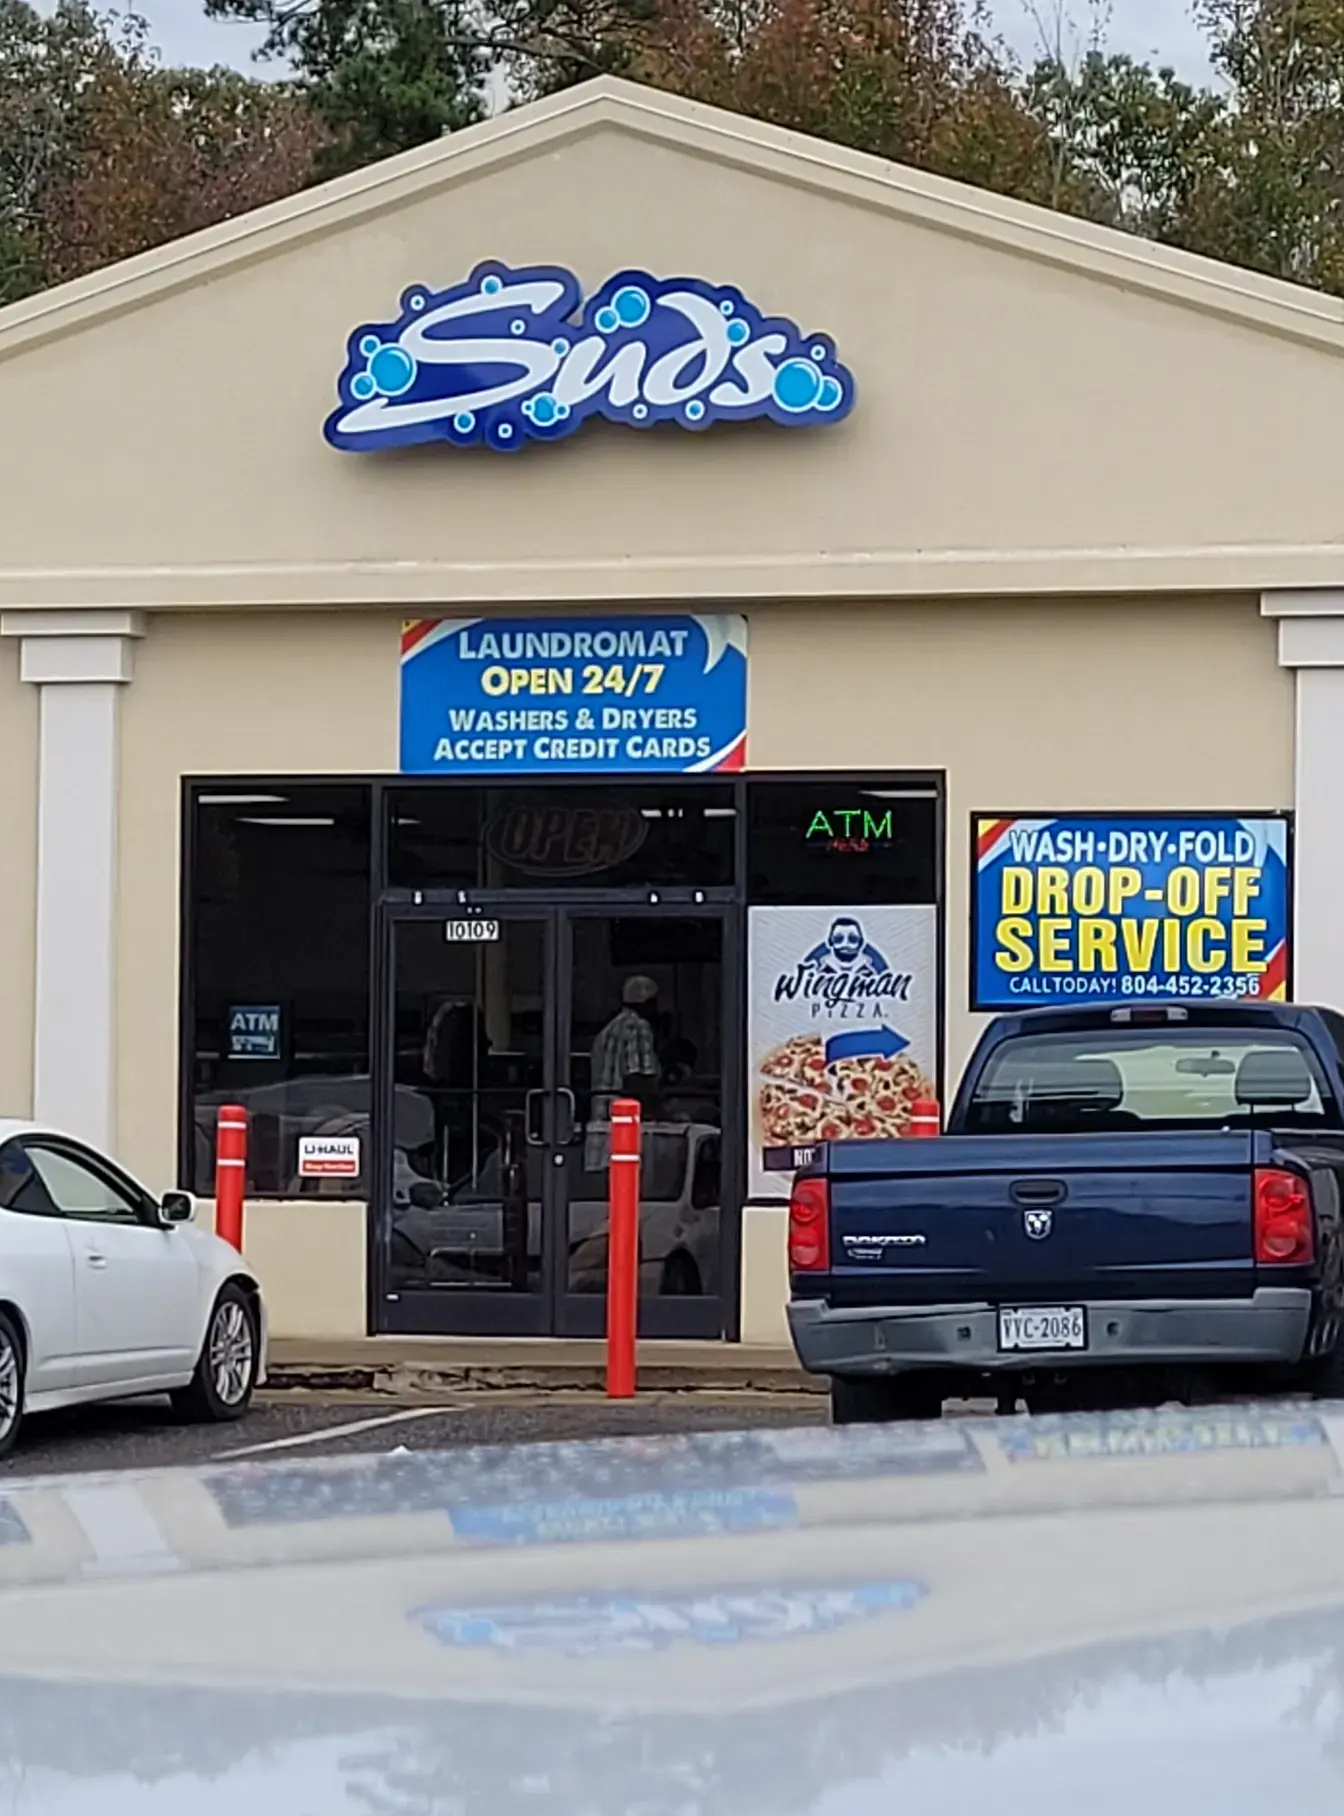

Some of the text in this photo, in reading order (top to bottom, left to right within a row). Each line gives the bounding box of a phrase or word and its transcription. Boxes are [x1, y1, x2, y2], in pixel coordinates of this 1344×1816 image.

[336, 280, 789, 434] Suds
[458, 629, 689, 660] LAUNDROMAT
[481, 664, 666, 698] OPEN 24/7
[448, 707, 698, 732] WASHERS & DRYERS
[433, 736, 711, 762] ACCEPT CREDIT CARDS
[805, 809, 893, 839] ATM
[1001, 866, 1262, 917] DROP-OFF
[449, 921, 496, 938] 10109
[994, 916, 1268, 973] SERVICE
[774, 963, 913, 1009] Wingman
[1121, 974, 1261, 996] 804-452-2356
[230, 1012, 279, 1031] ATM
